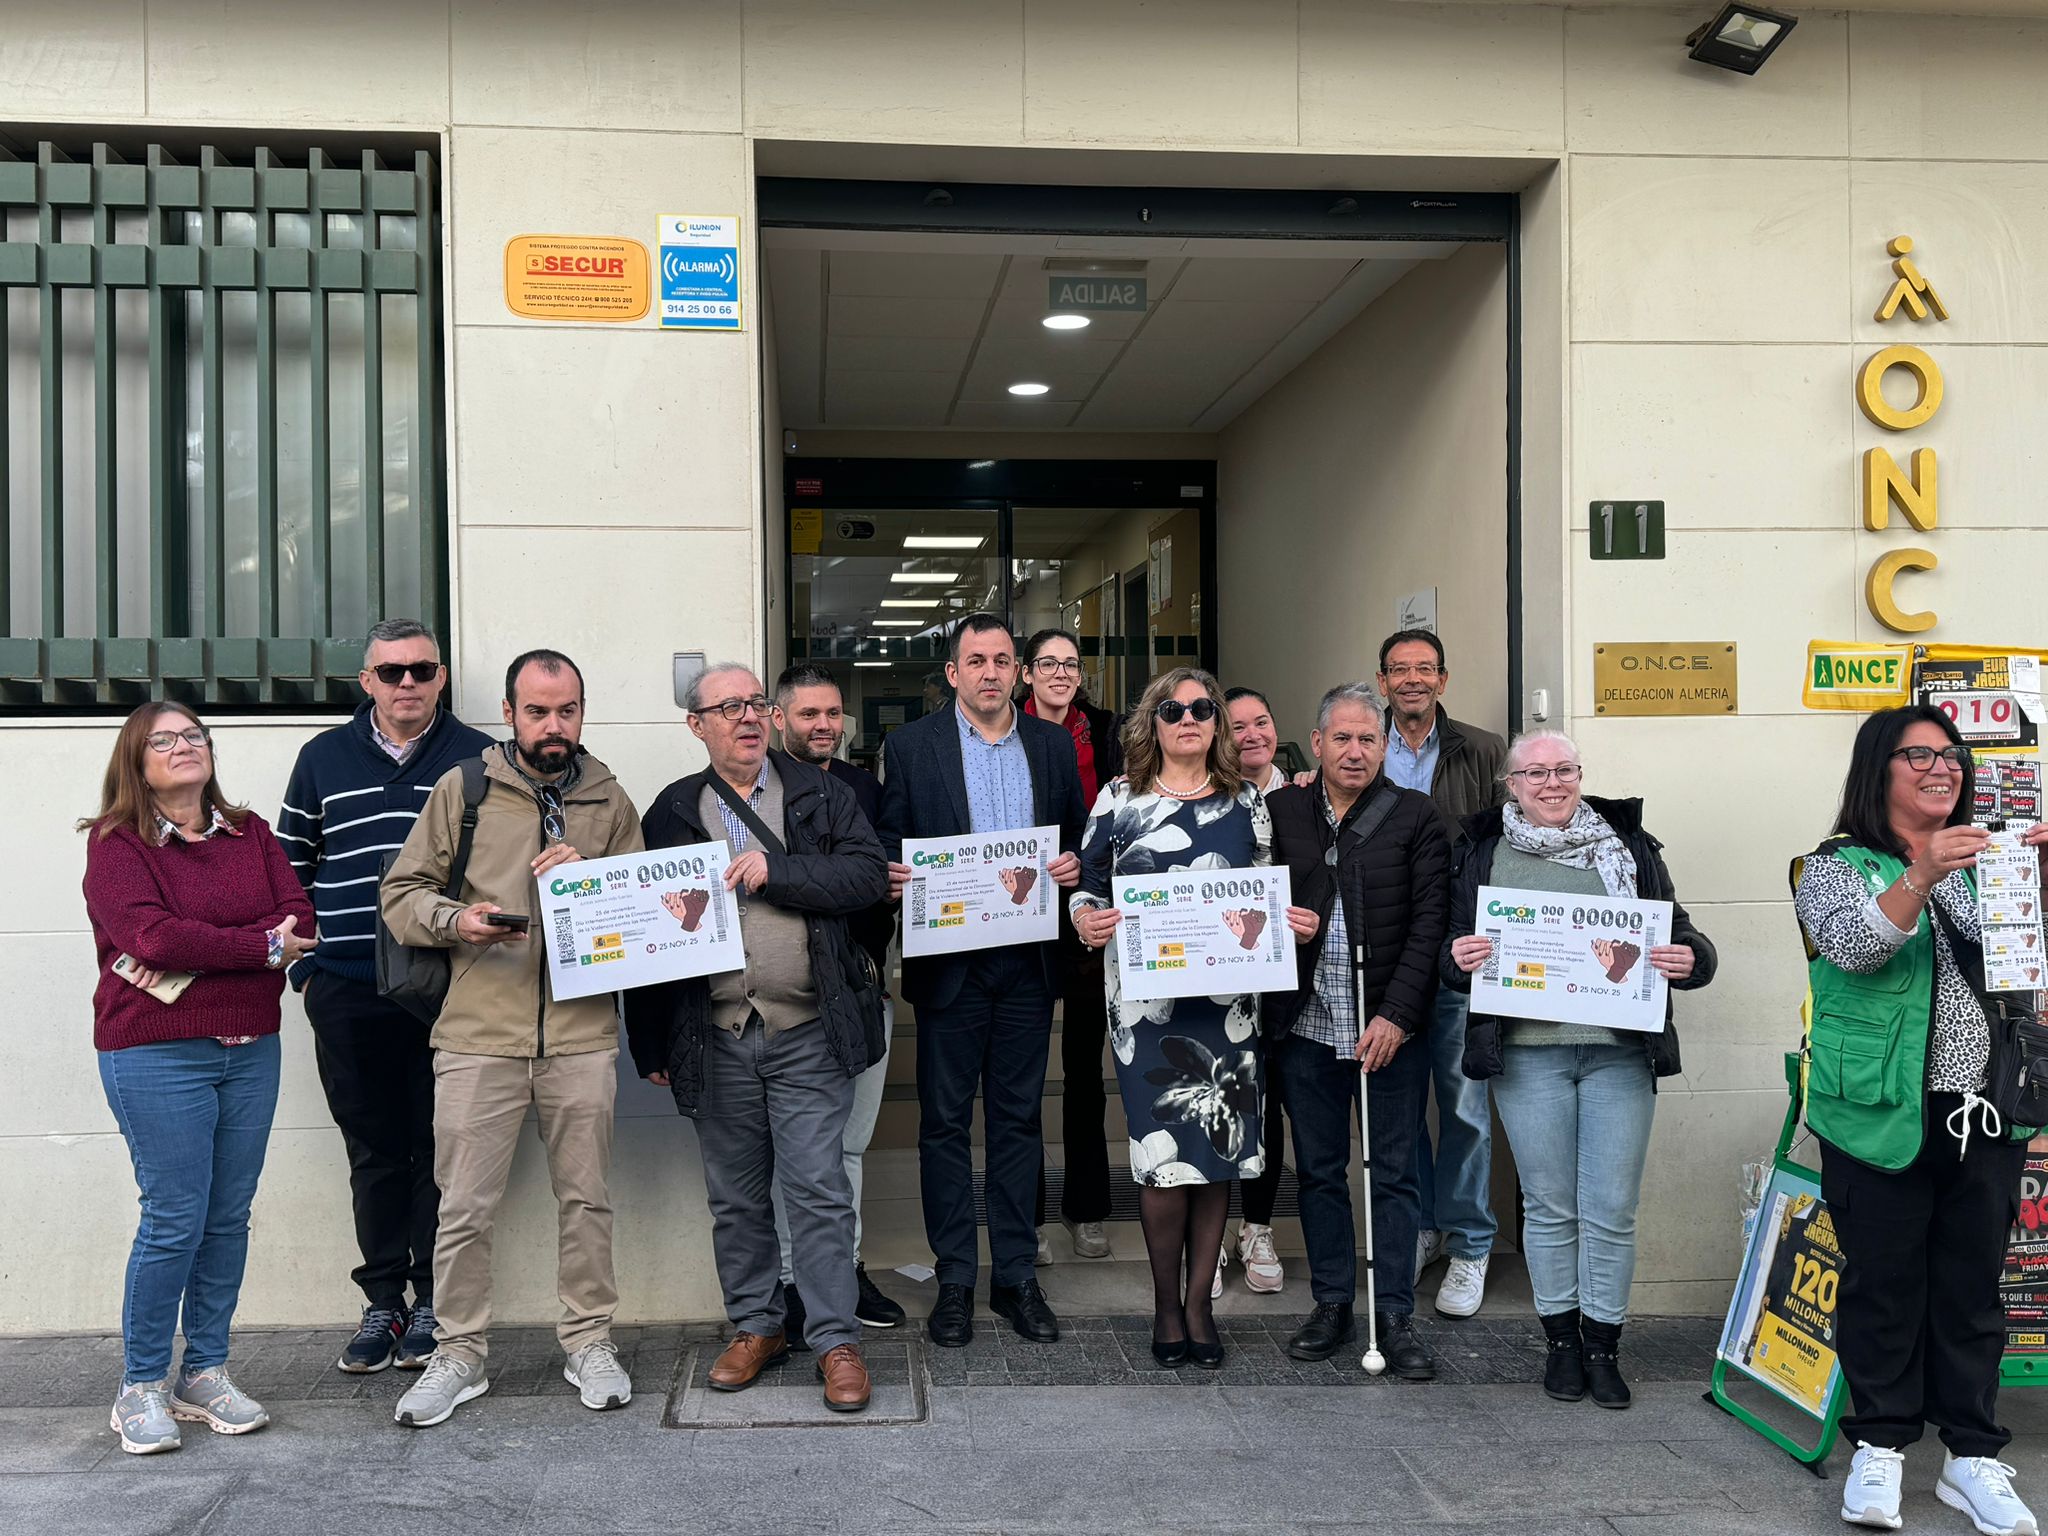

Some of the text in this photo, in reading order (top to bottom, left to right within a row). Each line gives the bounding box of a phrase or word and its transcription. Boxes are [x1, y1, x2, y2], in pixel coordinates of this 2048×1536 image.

[544, 256, 624, 273] SECUR
[679, 262, 720, 273] ALARMA
[688, 305, 700, 313] 25
[703, 305, 716, 314] 00
[719, 306, 732, 314] 66
[1601, 504, 1648, 553] 11
[1620, 656, 1713, 670] O.N.C.E.
[1835, 659, 1898, 684] ONCE
[1952, 680, 1967, 690] DE
[1604, 688, 1729, 700] DELEGACION ALMERIA
[958, 846, 977, 857] 000
[982, 839, 1038, 860] 00000
[605, 869, 629, 882] 000
[636, 856, 705, 884] 00000
[1173, 884, 1194, 895] 000
[1201, 879, 1265, 899] 00000
[939, 917, 964, 925] ONCE
[1541, 905, 1564, 917] 000
[1572, 907, 1643, 929] 00000
[689, 937, 698, 945] 25
[593, 951, 624, 962] ONCE
[1158, 960, 1185, 968] ONCE
[1514, 979, 1543, 989] ONCE
[1791, 1252, 1840, 1314] 120
[2009, 1293, 2023, 1302] QUE
[2024, 1293, 2032, 1301] ES
[1784, 1295, 1831, 1330] MILLONES
[1776, 1326, 1819, 1360] MILLONARIO
